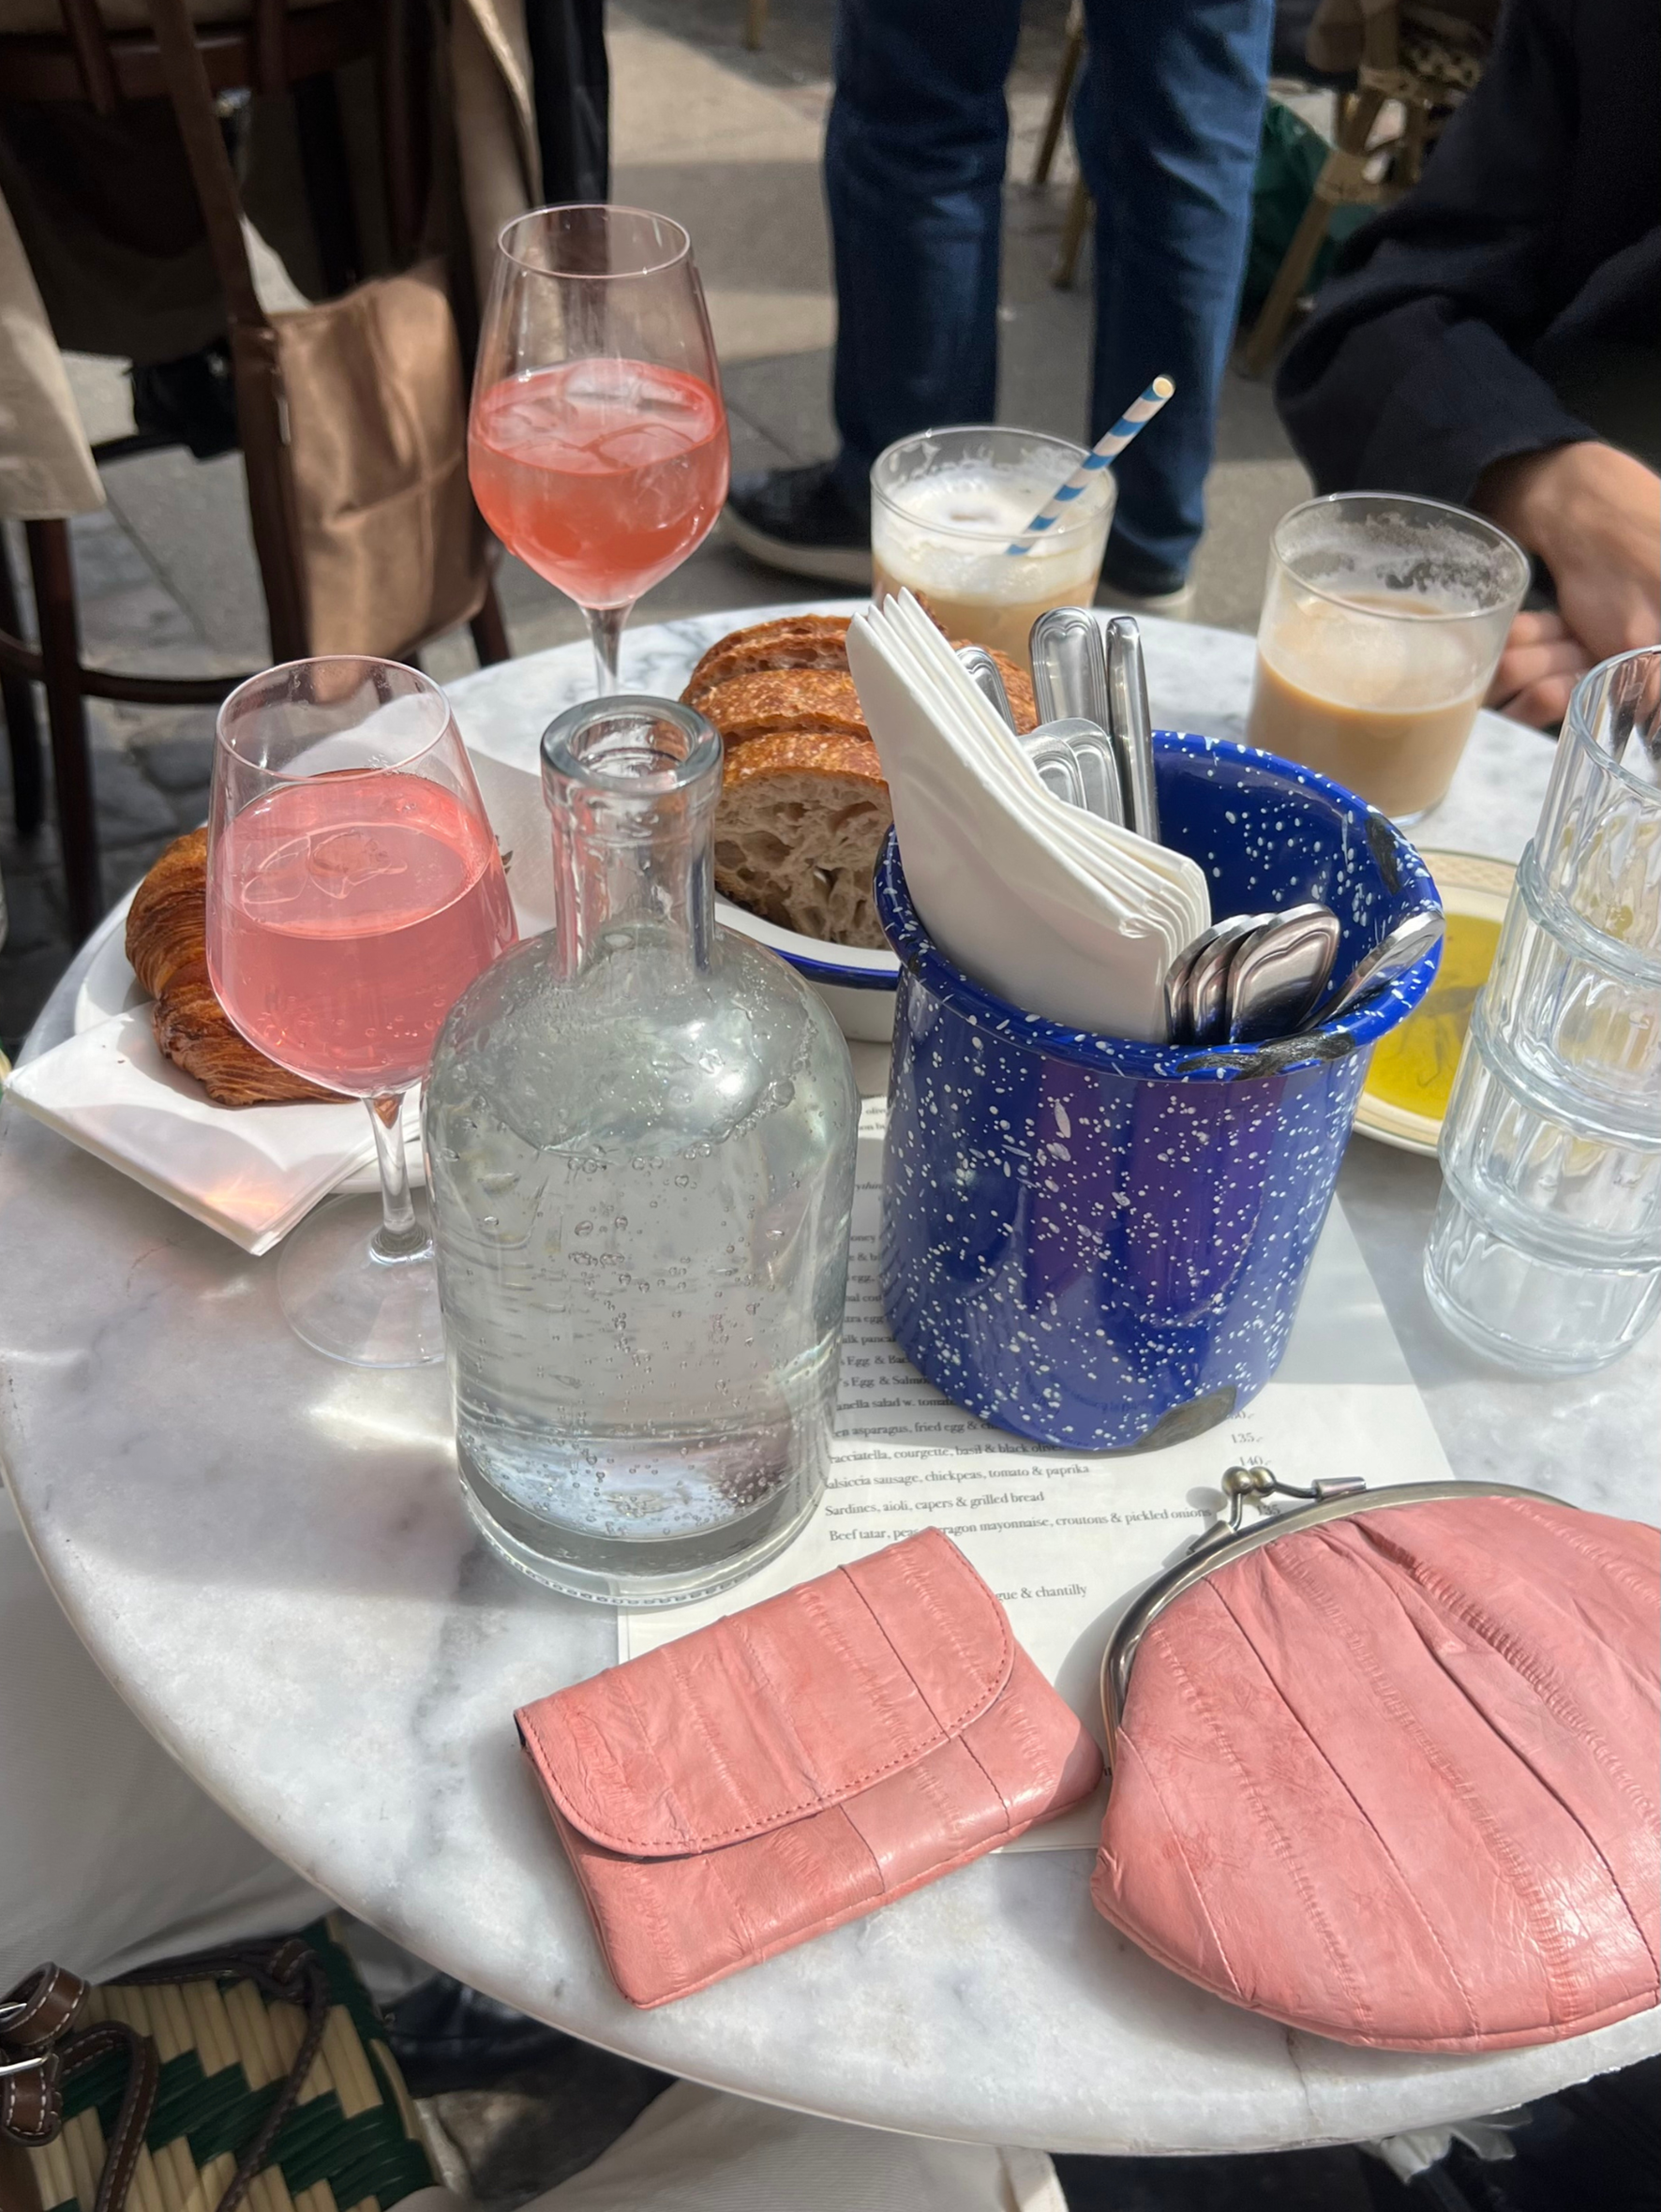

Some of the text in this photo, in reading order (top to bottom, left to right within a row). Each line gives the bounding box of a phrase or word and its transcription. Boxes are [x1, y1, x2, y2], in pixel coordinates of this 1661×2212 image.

[850, 1234, 876, 1244] oney
[863, 1315, 884, 1326] egg
[846, 1356, 870, 1368] Egg
[875, 1355, 886, 1366] &
[851, 1377, 875, 1389] Egg
[879, 1375, 891, 1386] &
[872, 1397, 900, 1408] salad
[902, 1398, 914, 1408] w.
[851, 1424, 911, 1438] asparagus,
[914, 1422, 942, 1433] fried
[944, 1423, 965, 1435] egg
[966, 1420, 979, 1431] &
[893, 1446, 954, 1460] courgette,
[955, 1444, 982, 1456] basil
[984, 1442, 995, 1454] &
[998, 1442, 1029, 1454] black
[874, 1474, 923, 1487] sausage,
[924, 1470, 987, 1484] chickpeas,
[988, 1468, 1029, 1478] tomato
[1031, 1465, 1043, 1476] &
[1045, 1463, 1089, 1479] paprika
[825, 1491, 1045, 1517] Sardines, aioli, capers & grilled bread
[830, 1529, 858, 1542] Beef
[860, 1529, 891, 1540] tatar,
[980, 1516, 1055, 1533] mayonnaise,
[1055, 1514, 1109, 1526] croutons
[1110, 1512, 1122, 1523] &
[1124, 1509, 1169, 1526] pickled
[1171, 1507, 1212, 1519] onions
[1020, 1587, 1032, 1599] &
[1035, 1583, 1087, 1598] chantilly
